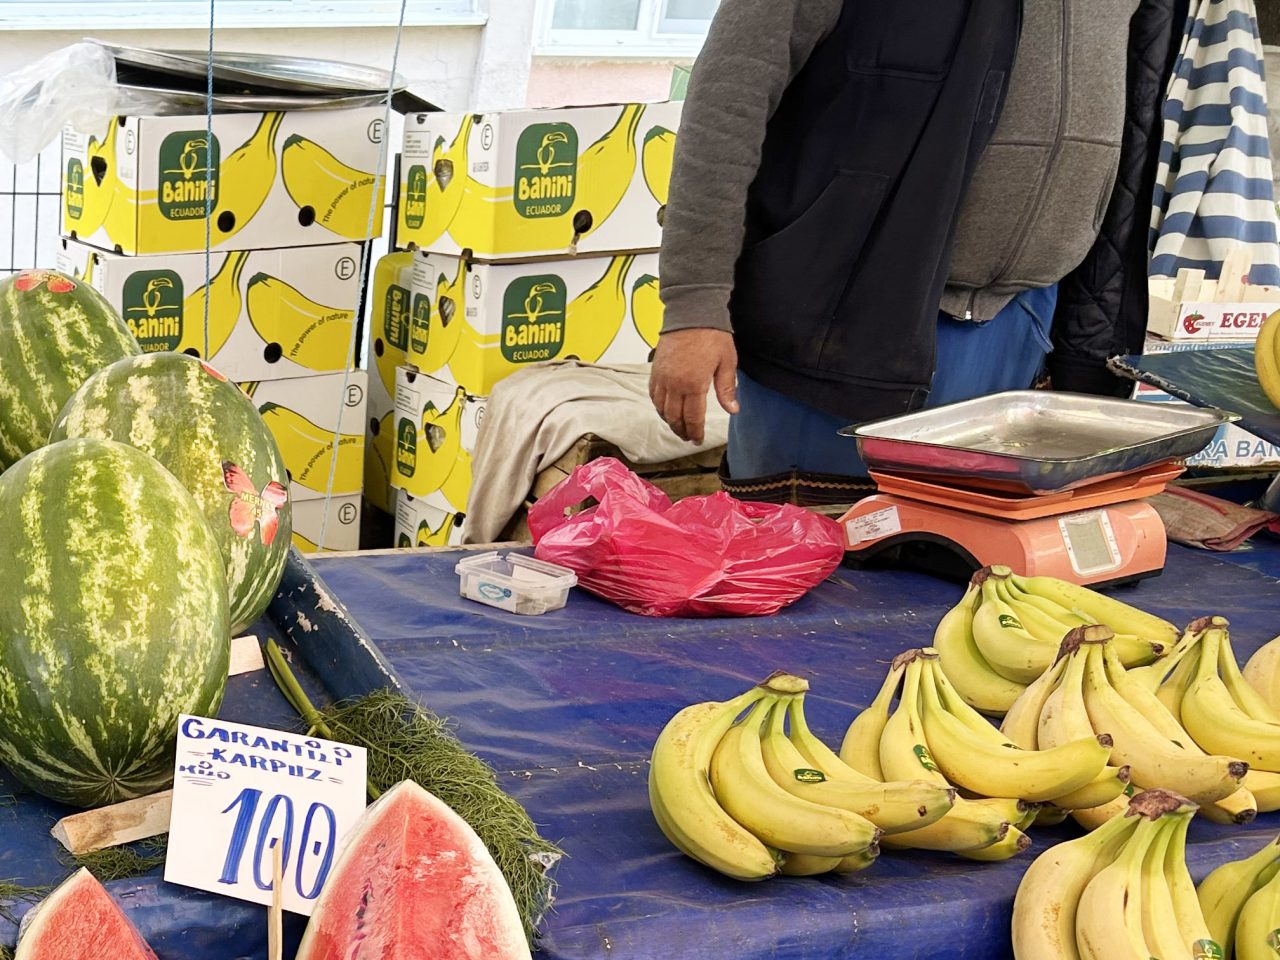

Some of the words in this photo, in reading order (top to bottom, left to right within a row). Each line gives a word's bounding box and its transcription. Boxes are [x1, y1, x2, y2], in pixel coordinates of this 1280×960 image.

[162, 180, 216, 203] Banini
[322, 208, 333, 223] The
[331, 187, 349, 210] power
[350, 181, 357, 191] of
[358, 177, 376, 187] natu
[518, 175, 572, 200] Banini
[170, 206, 205, 217] ECUADOR
[526, 204, 561, 216] ECUADOR
[127, 316, 180, 339] Banini
[290, 342, 301, 357] The
[298, 321, 317, 344] power
[317, 316, 325, 326] of
[326, 312, 349, 322] nature
[505, 322, 561, 347] Banini
[140, 342, 169, 352] CUADOR
[512, 349, 549, 360] ECUADOR
[299, 468, 309, 481] The
[307, 447, 325, 468] power
[326, 441, 333, 451] of
[337, 437, 357, 446] ature
[210, 748, 323, 781] KARPUZ
[217, 788, 337, 899] 100
